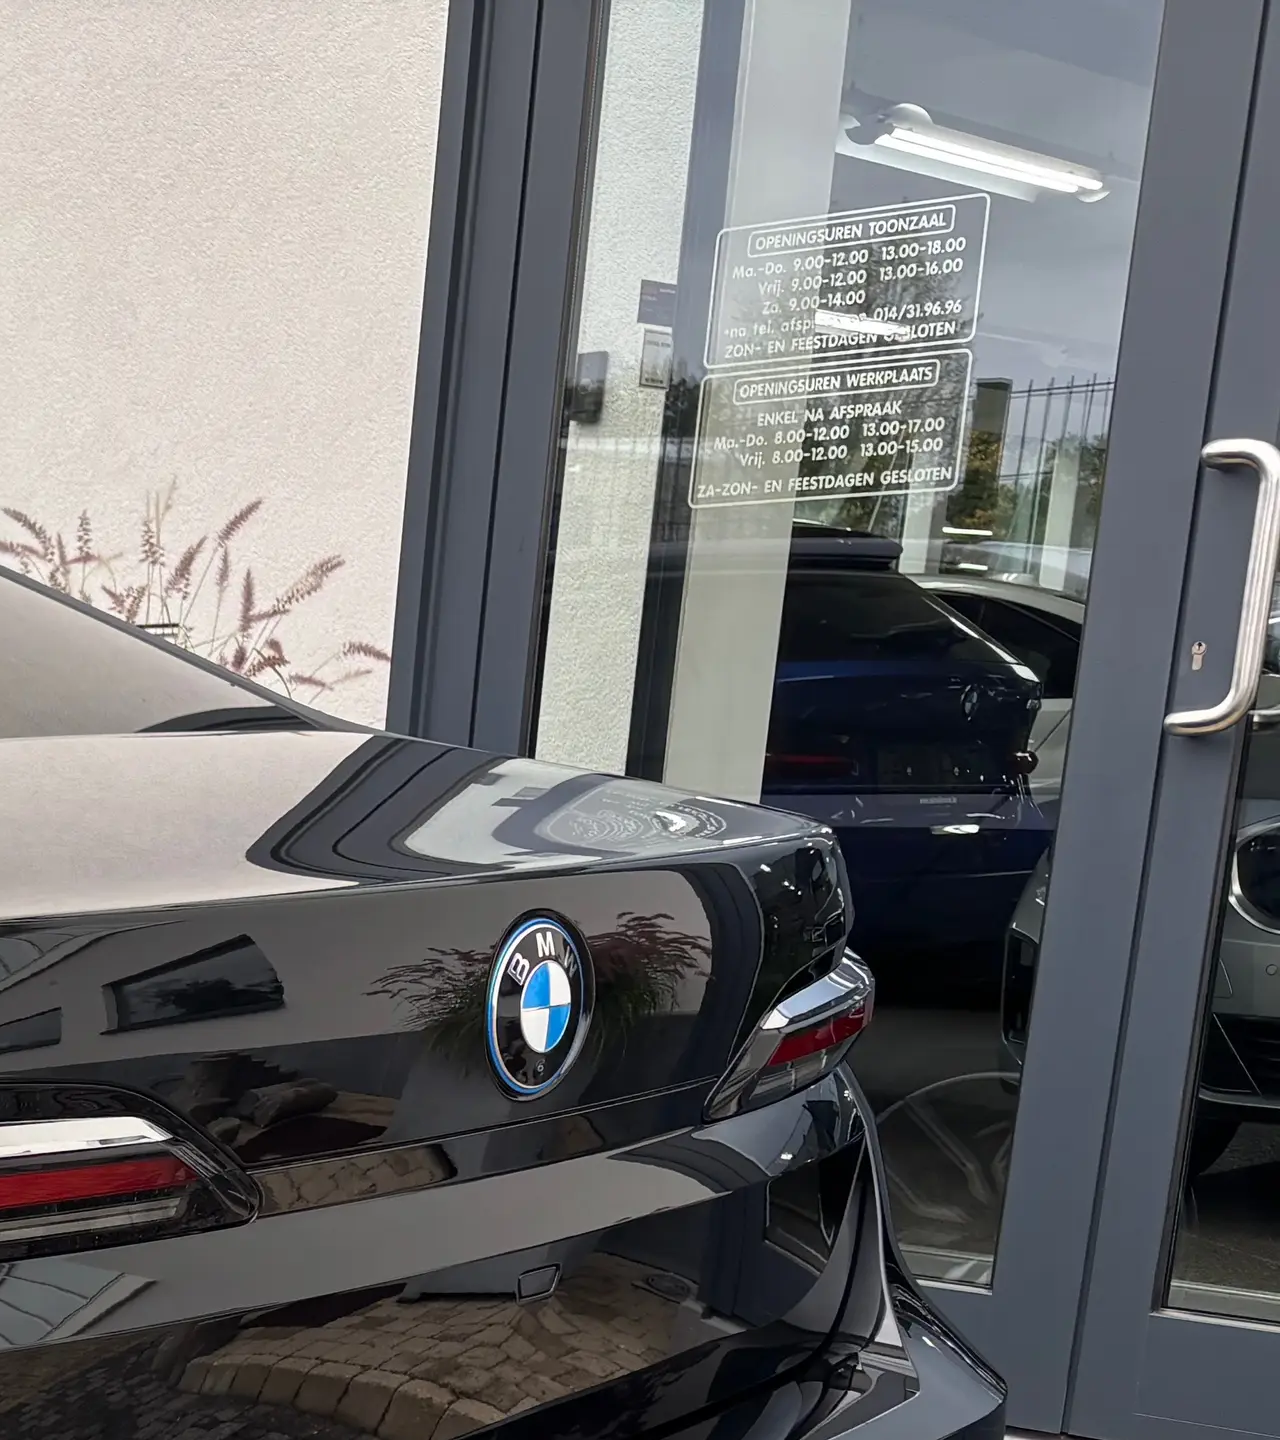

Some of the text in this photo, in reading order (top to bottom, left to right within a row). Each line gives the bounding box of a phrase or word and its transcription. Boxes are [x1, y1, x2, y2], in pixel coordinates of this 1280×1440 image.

[755, 213, 947, 250] OPENINGSUREN TOONZAAL
[732, 236, 966, 280] Ma.-Do. 9.00-12.00 13.00-18.00
[757, 258, 964, 297] Vrij. 9.00-12.00 13.00-16.00
[753, 320, 775, 335] tel.
[873, 299, 962, 322] 014/31.96.96
[761, 290, 867, 315] Za. 9.00-14.00
[724, 344, 761, 359] ZON-
[767, 340, 786, 354] EN
[790, 331, 878, 352] FEESTDAGEN
[739, 366, 933, 398] OPENINGSUREN WERKPLAATS
[757, 400, 903, 427] ENKEL NA AFSPRAAK
[713, 416, 946, 450] Ma.-Do. 8.00-12.00 13.00-17.00
[739, 436, 943, 470] Vrij. 8.00-12.00 13.00-15.00
[697, 465, 953, 499] ZA-ZON- EN FEESTDAGEN GESLOTEN
[506, 931, 578, 987] BMW
